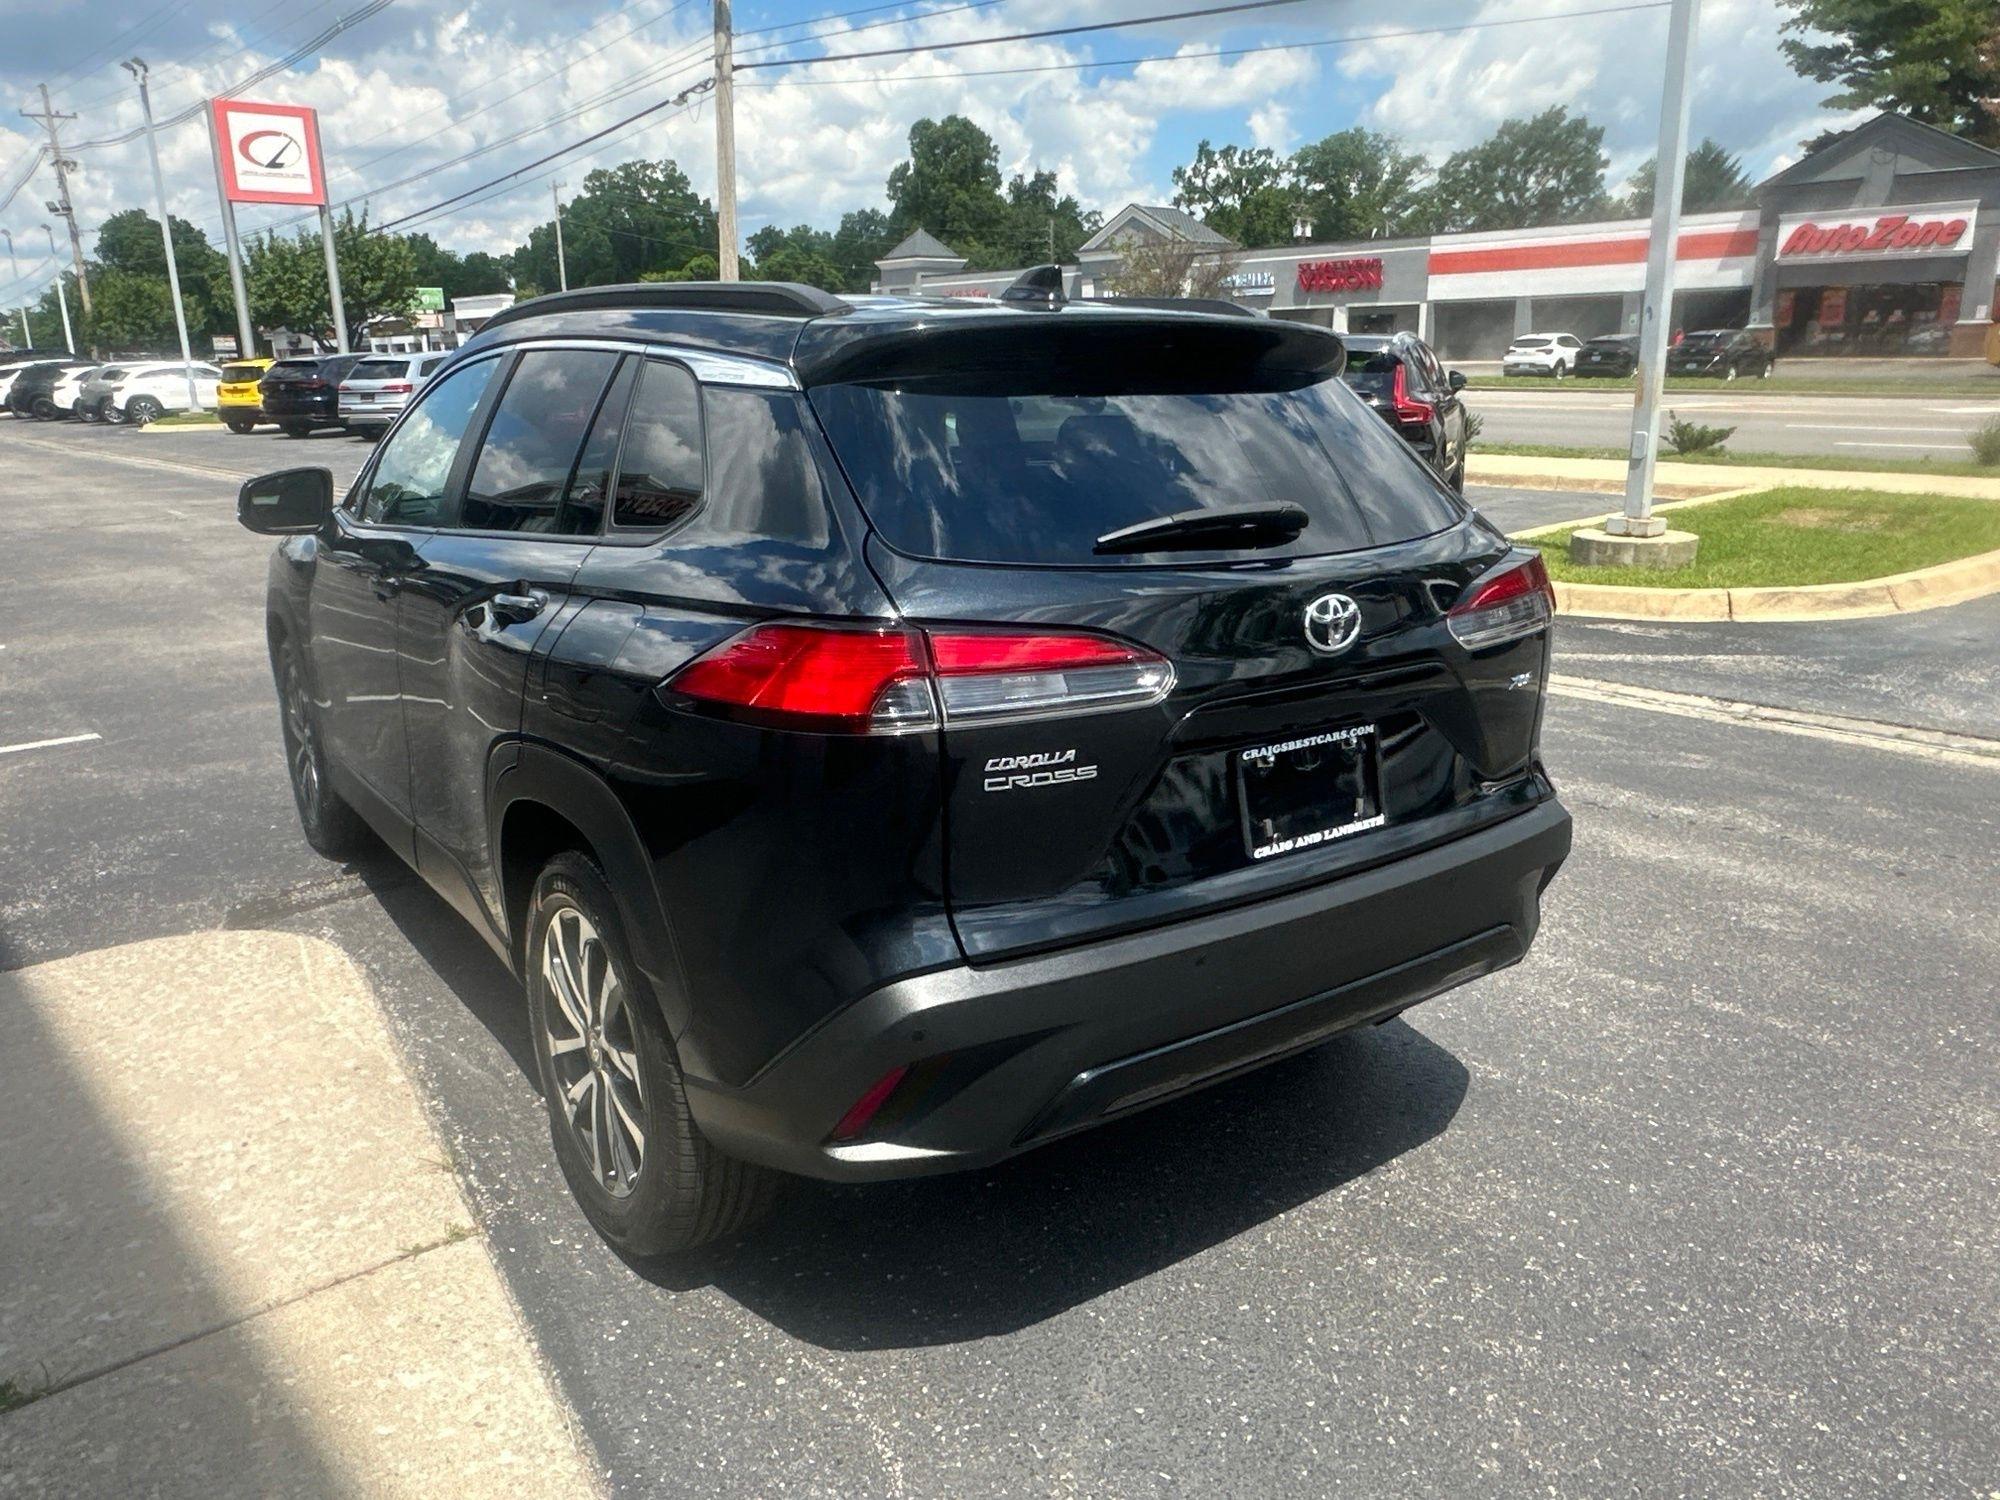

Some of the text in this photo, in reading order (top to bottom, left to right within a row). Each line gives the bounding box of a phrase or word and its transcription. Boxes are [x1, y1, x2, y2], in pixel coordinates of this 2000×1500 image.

[1780, 216, 1968, 255] AutoZone
[1242, 724, 1375, 761] CRAIGSBESTCARS.COM
[984, 749, 1076, 772] COROLLA
[984, 765, 1098, 791] CROSS
[1253, 839, 1294, 859] CRAIG
[1295, 832, 1323, 848] AND
